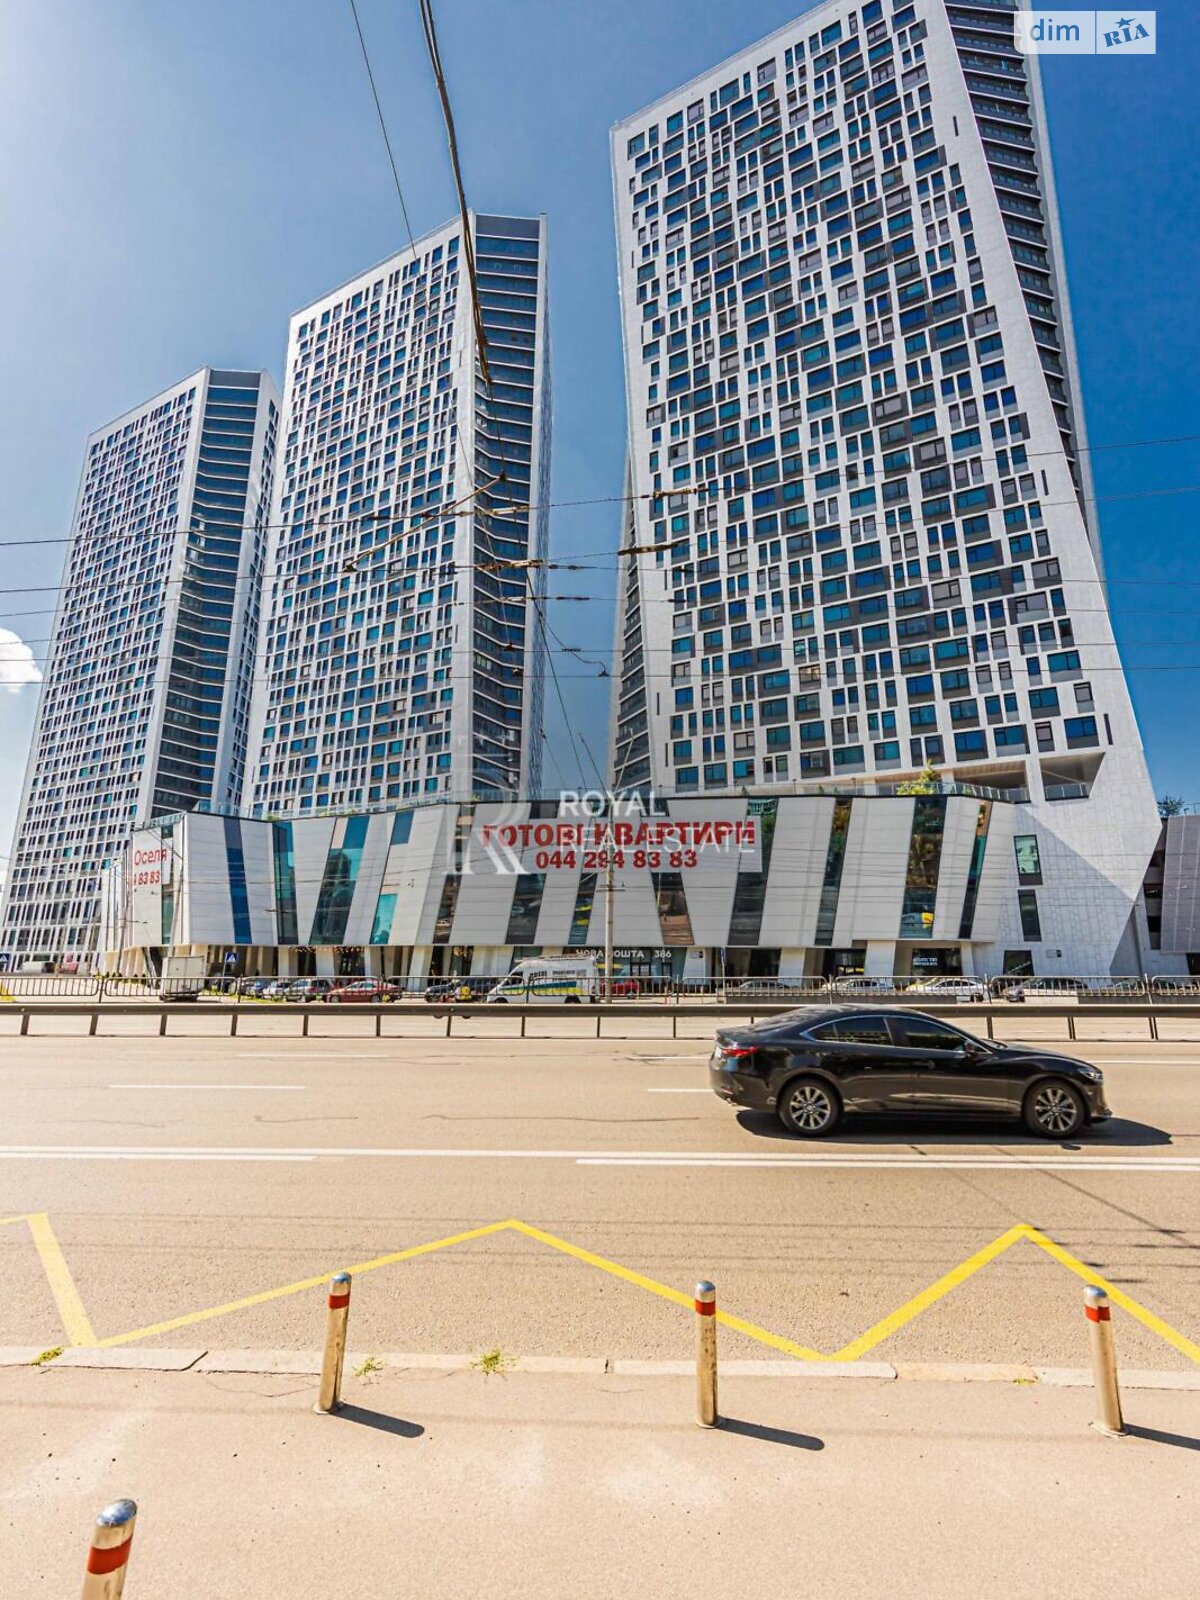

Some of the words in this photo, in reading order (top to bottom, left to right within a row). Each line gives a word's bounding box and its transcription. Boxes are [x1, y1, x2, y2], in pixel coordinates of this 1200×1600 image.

[134, 849, 168, 866] Оселя
[535, 850, 577, 870] 044
[632, 850, 661, 869] 83
[669, 849, 698, 868] 83
[612, 949, 646, 959] ОШТА
[654, 949, 672, 958] 386
